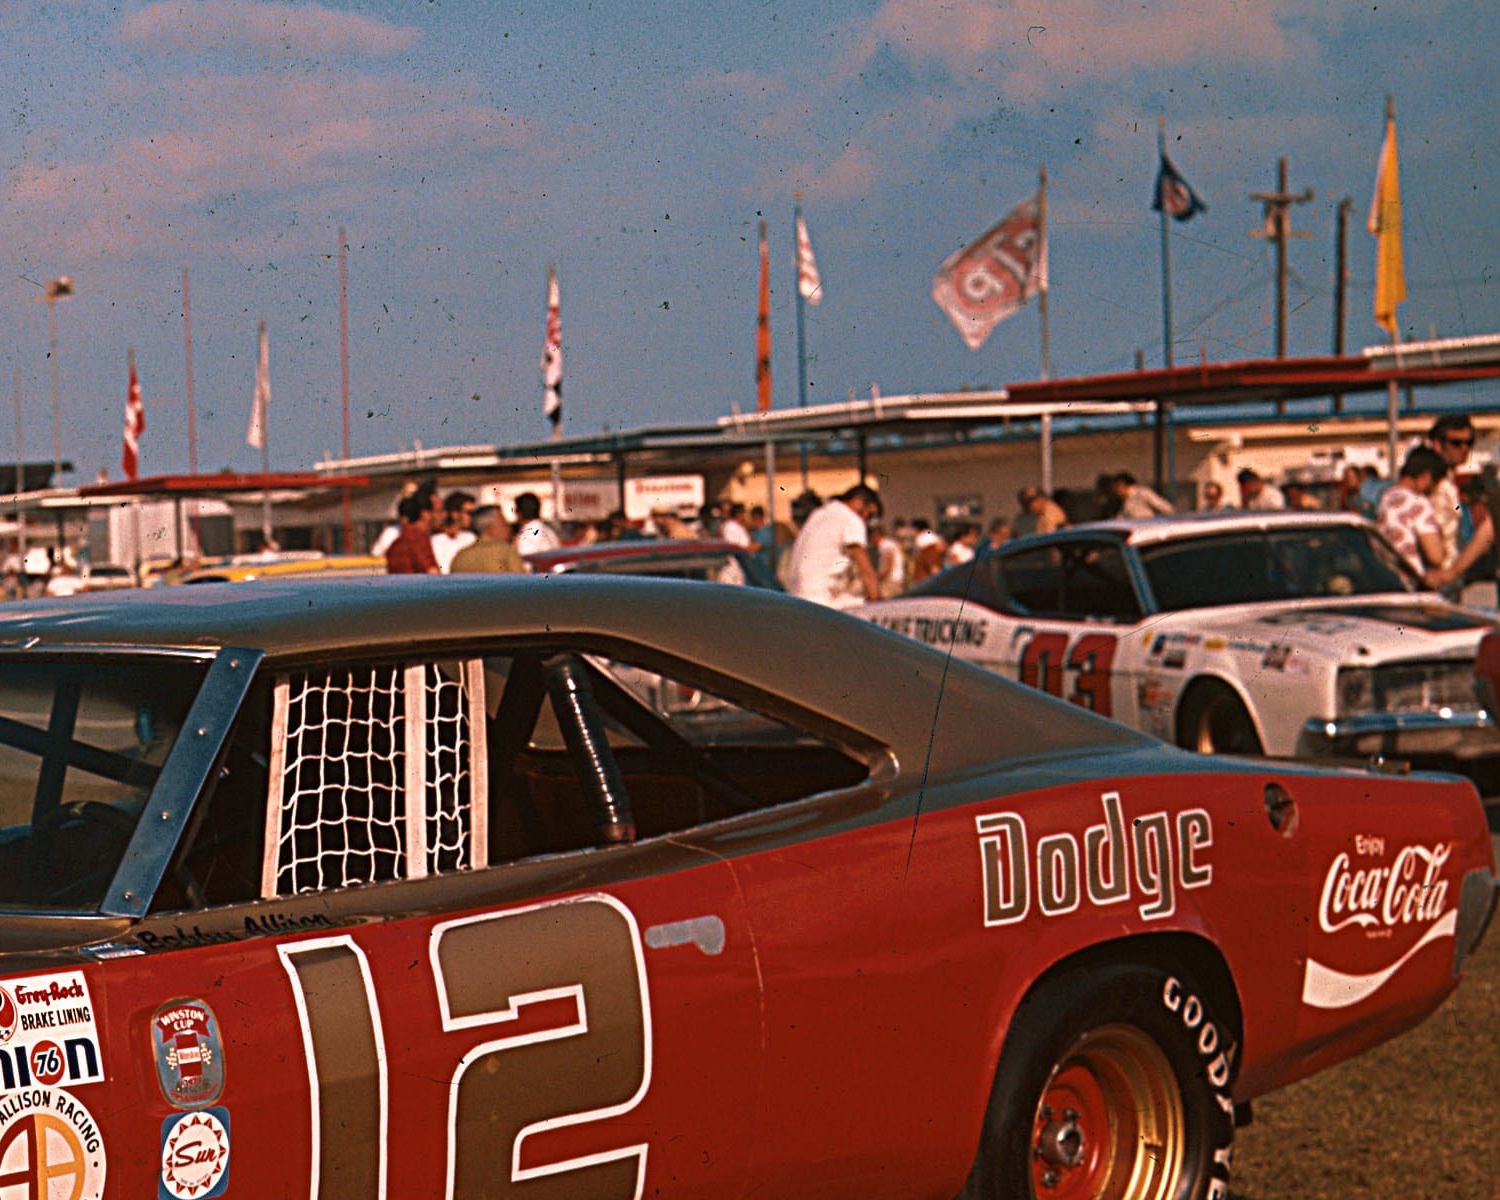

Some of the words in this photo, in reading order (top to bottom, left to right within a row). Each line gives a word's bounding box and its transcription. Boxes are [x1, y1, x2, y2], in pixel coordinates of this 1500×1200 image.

[1355, 835, 1385, 855] Enjoy
[975, 791, 1213, 927] Dodge
[244, 913, 332, 933] Allison
[21, 1011, 57, 1031] BRAKE
[57, 1006, 91, 1027] LINING
[160, 1009, 205, 1027] WINSTON
[173, 1019, 195, 1031] CUP
[56, 1095, 100, 1154] RACING
[174, 1140, 217, 1168] Sun
